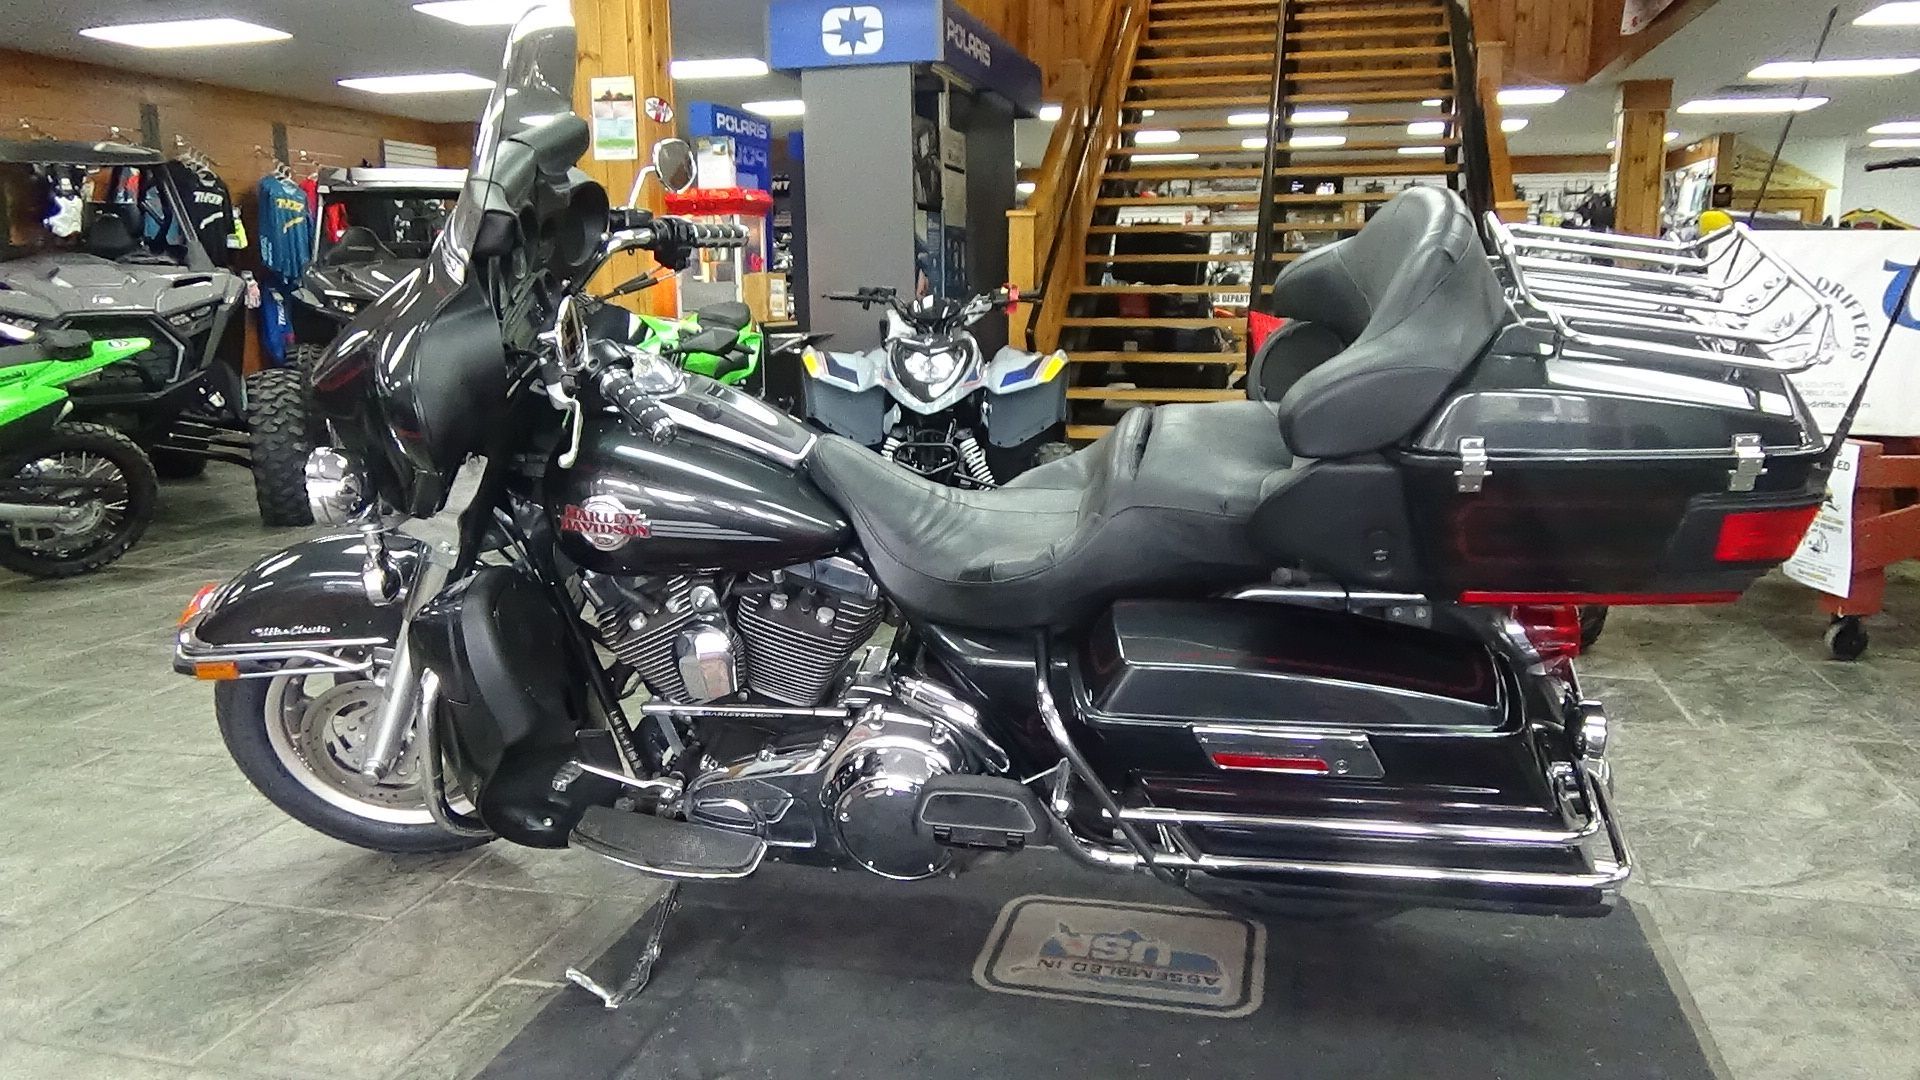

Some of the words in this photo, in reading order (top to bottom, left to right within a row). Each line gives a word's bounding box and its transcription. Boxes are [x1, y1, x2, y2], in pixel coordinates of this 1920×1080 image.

[946, 15, 991, 68] POLARIS
[716, 112, 767, 139] POLARIS
[1221, 294, 1249, 303] DEPART
[1815, 276, 1870, 361] DRIFTERS
[561, 519, 652, 538] DAVIDSON
[1036, 958, 1062, 969] IN
[1071, 962, 1220, 986] ASSEMBLED
